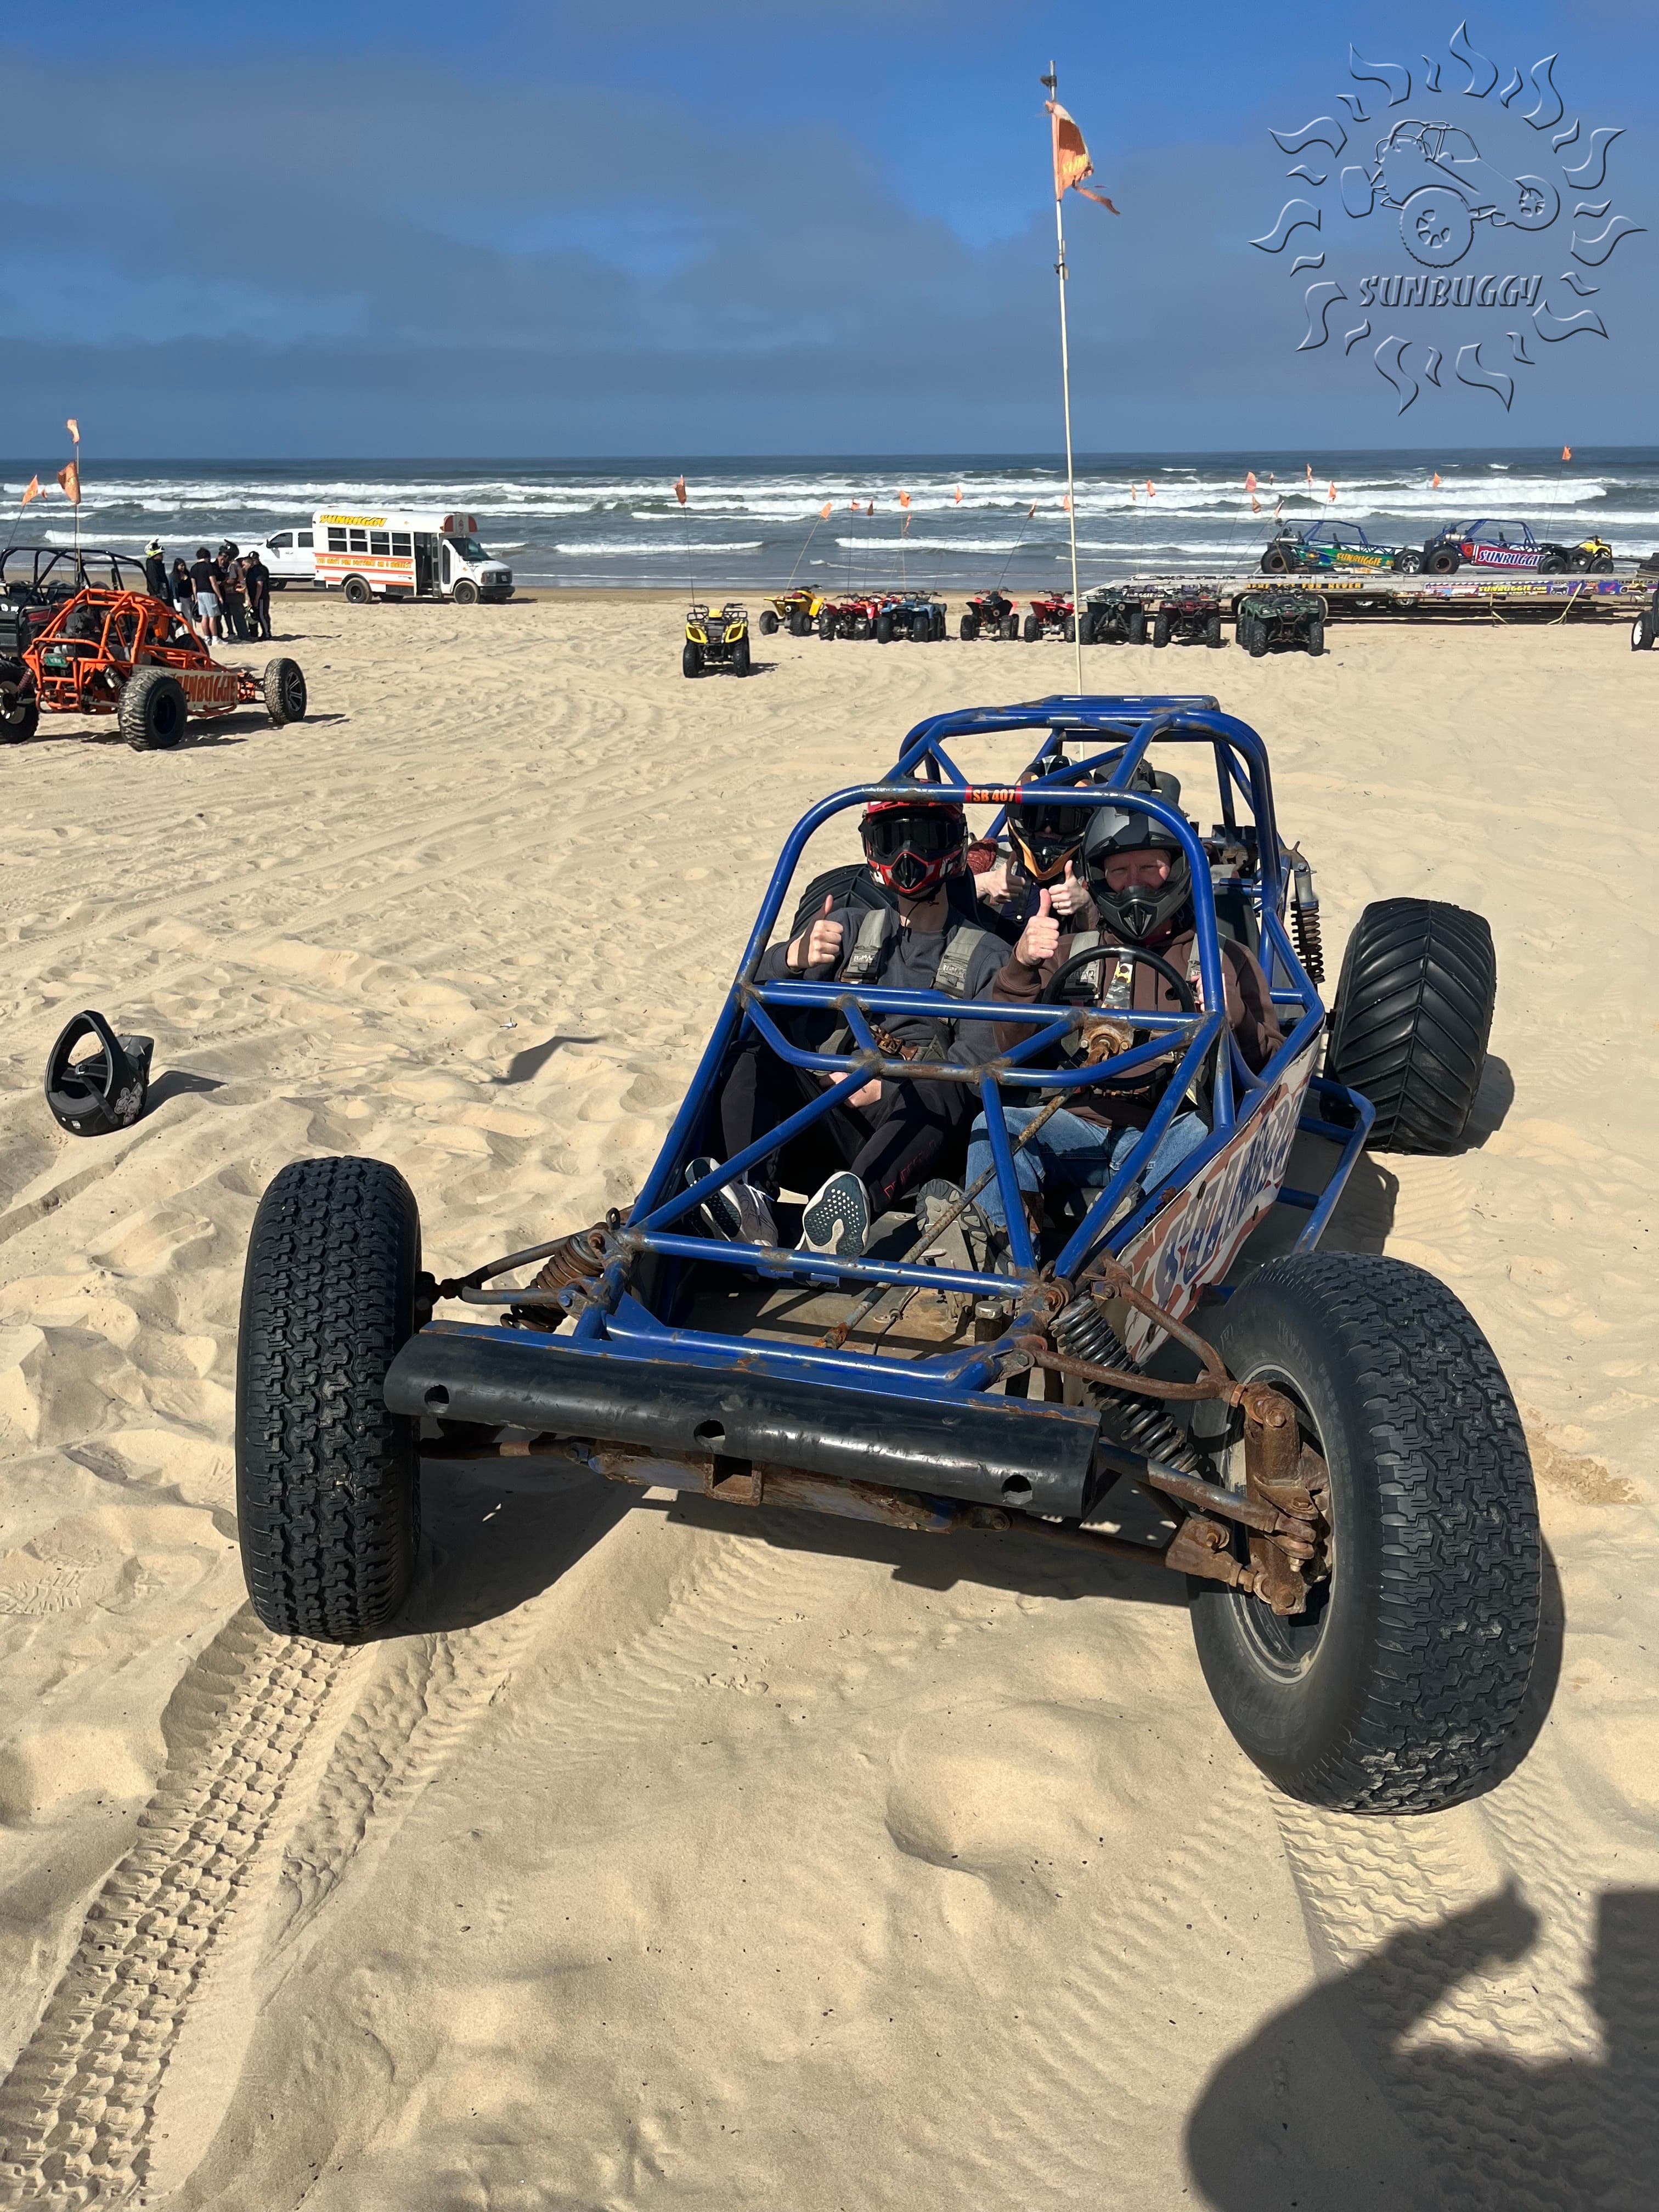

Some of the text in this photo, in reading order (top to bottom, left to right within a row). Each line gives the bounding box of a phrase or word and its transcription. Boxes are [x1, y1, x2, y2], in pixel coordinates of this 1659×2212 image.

[1336, 552, 1383, 566] SUNBUGGIE
[973, 789, 1015, 802] SB 407
